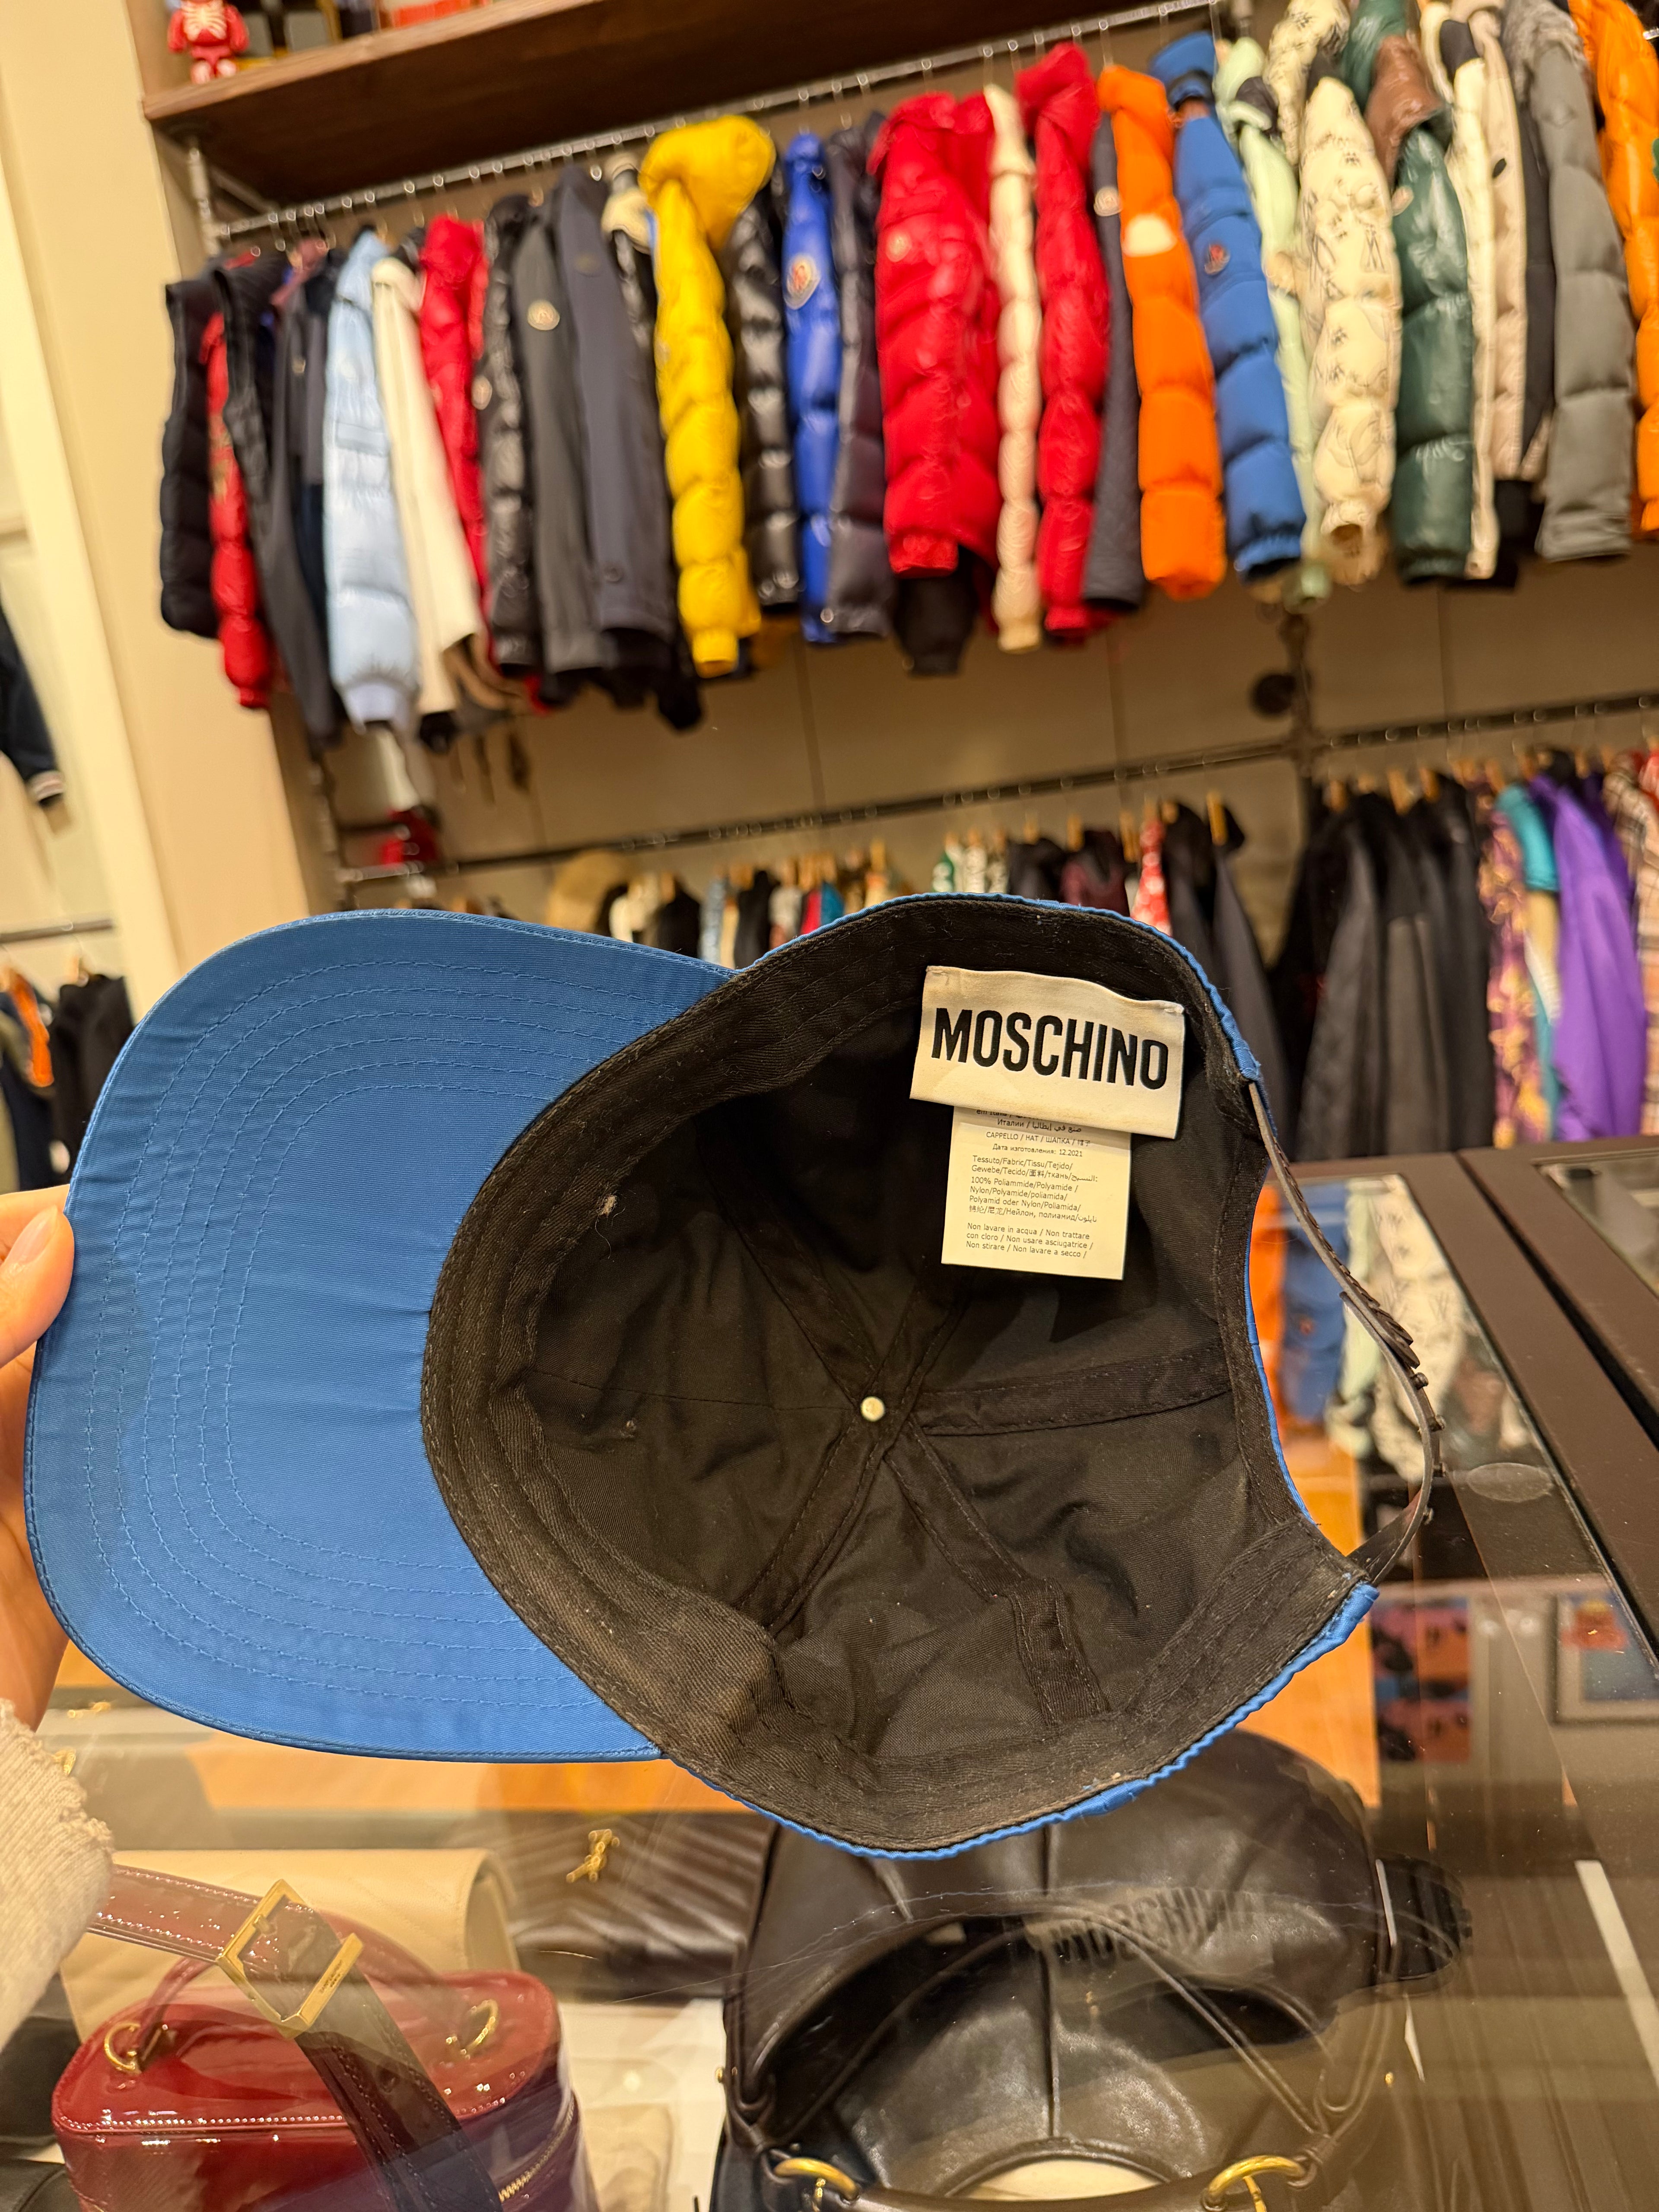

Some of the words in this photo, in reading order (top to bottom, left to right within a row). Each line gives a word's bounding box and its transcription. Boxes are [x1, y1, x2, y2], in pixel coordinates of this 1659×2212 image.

[931, 1007, 1168, 1090] MOSCHINO
[998, 1119, 1023, 1127] Италии
[973, 1155, 1073, 1170] Tessuto/Fabric/Tissu/Tejido/
[994, 1178, 1072, 1191] Poliammide/Polyamide
[970, 1186, 1068, 1201] Nylon/Polyamide/poliamida/
[969, 1195, 1000, 1204] Polyamid
[1022, 1200, 1081, 1212] Nylon/Poliamida/
[1046, 1240, 1087, 1248] asciugatrice
